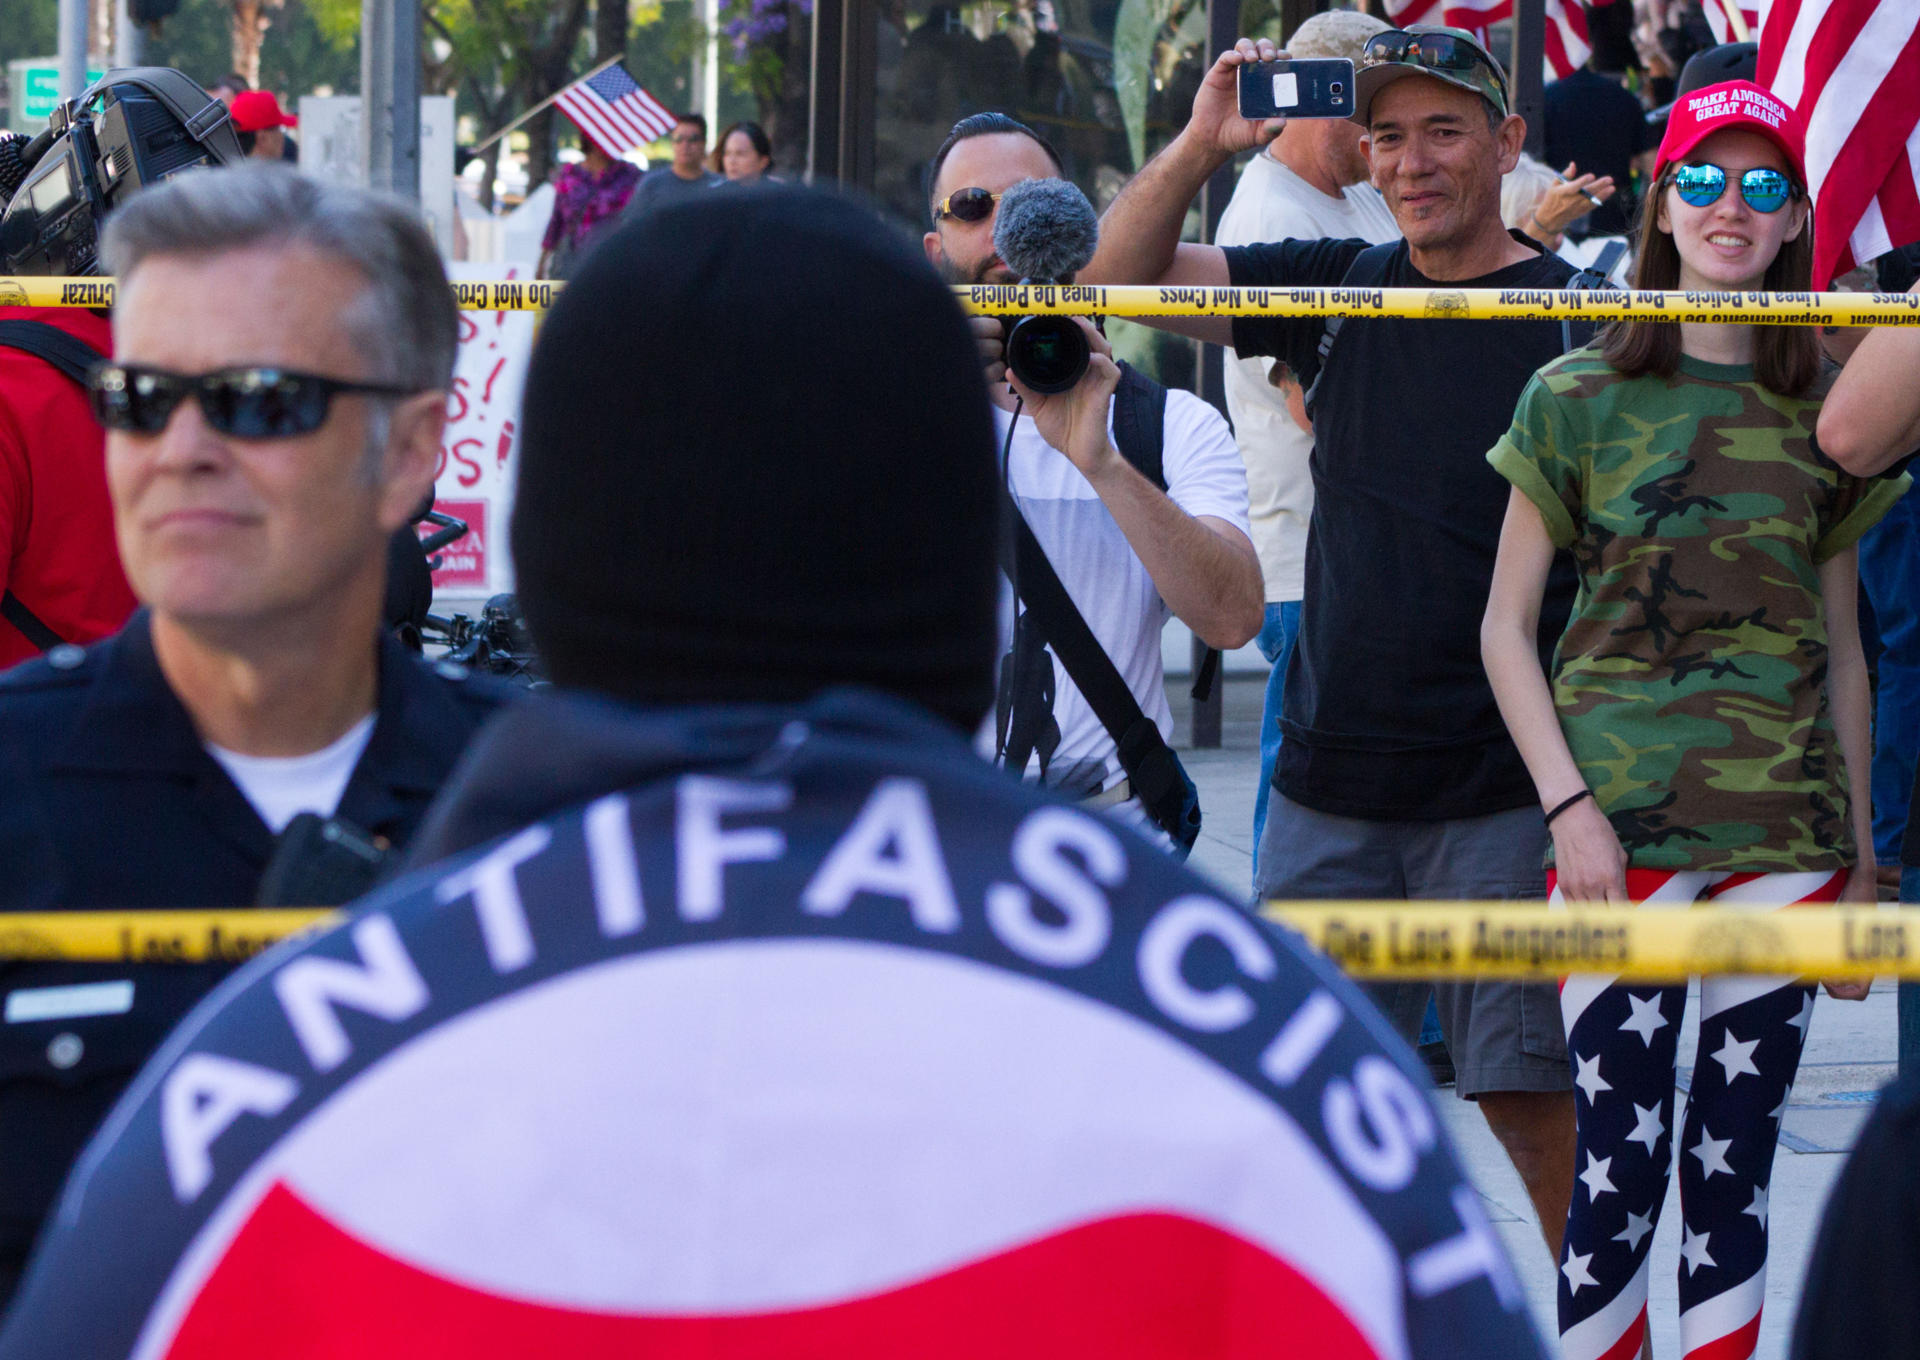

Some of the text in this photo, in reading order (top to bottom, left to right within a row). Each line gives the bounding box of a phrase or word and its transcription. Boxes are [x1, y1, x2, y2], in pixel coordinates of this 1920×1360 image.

[1688, 89, 1787, 122] MAKE AMERICA
[1696, 101, 1780, 129] GREAT AGAIN
[61, 283, 116, 307] Cruzar
[494, 284, 522, 309] Not
[1034, 286, 1056, 308] De
[1061, 286, 1107, 308] Linea
[1160, 288, 1206, 309] Cross
[1213, 288, 1241, 308] Not
[1331, 288, 1383, 309] Police
[1499, 291, 1554, 310] Cruzar
[1559, 291, 1582, 310] No
[1587, 291, 1632, 309] Favor
[1389, 916, 1454, 964] Los
[1472, 917, 1629, 965] Angeles
[1843, 912, 1907, 961] Los
[162, 777, 1524, 1312] ANTIFASCIST
